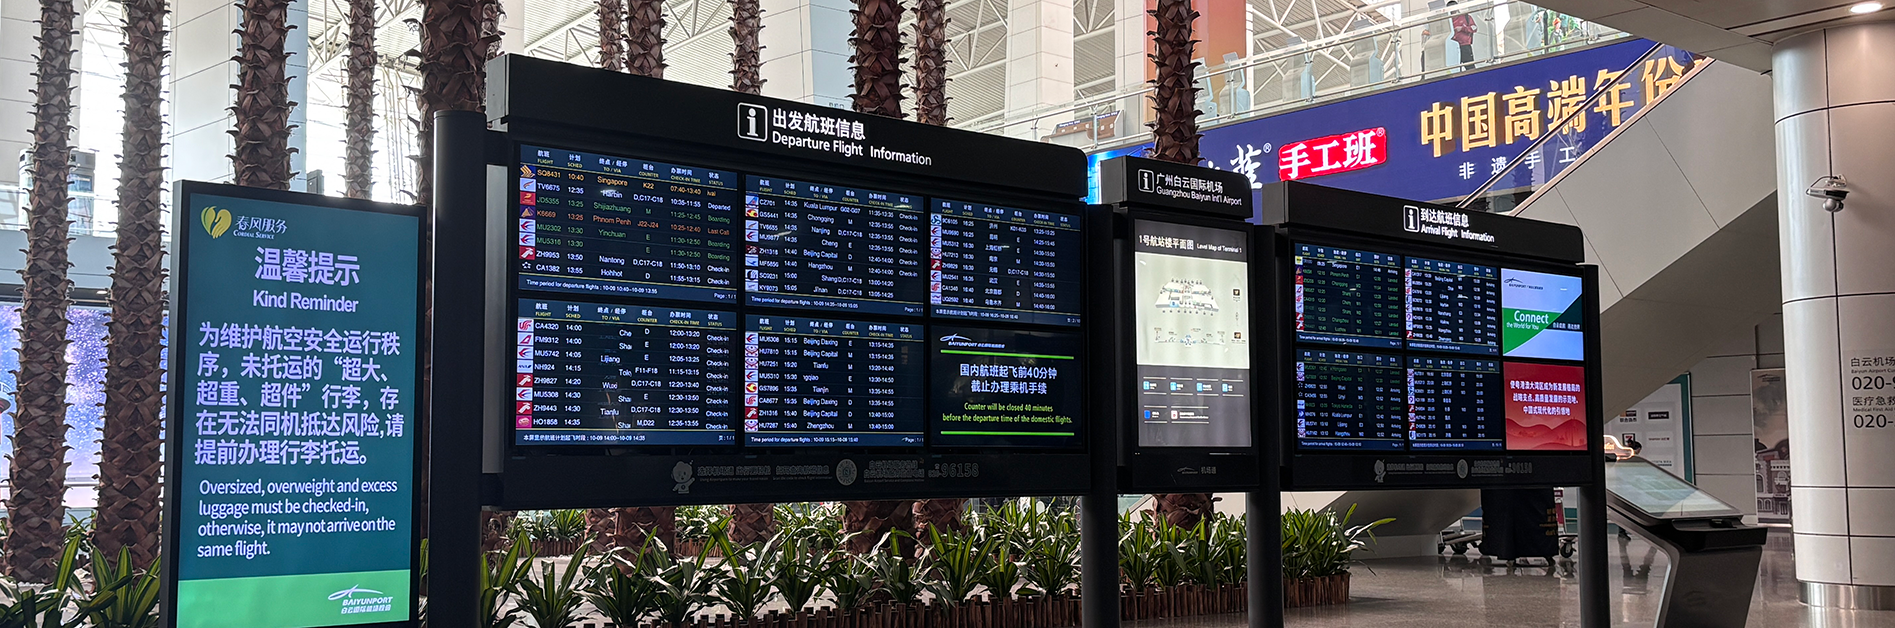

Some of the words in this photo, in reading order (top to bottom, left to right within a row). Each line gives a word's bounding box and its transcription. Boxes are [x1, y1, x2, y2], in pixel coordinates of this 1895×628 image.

[1420, 56, 1704, 158] 中国高端年份
[772, 108, 865, 140] 出发航班信息
[772, 131, 830, 151] Departure
[833, 140, 863, 157] Flight
[870, 146, 931, 165] Information
[1280, 131, 1377, 178] 手工班
[597, 176, 628, 186] Singapore
[1156, 173, 1223, 193] 广州白云国际机场
[1156, 186, 1190, 198] Guangzhou
[1191, 191, 1211, 202] Baiyun
[1223, 196, 1242, 205] Airport
[594, 202, 631, 213] Shijiazhuang
[708, 215, 730, 224] Boarding
[708, 203, 731, 211] Departed
[236, 215, 287, 234] 春风服务
[808, 214, 834, 223] Chongqing
[1420, 208, 1469, 227] 到达航班信息
[599, 229, 626, 238] Yinchuan
[708, 241, 730, 249] Boarding
[811, 227, 830, 235] Nanjing
[1421, 224, 1440, 235] Arrival
[1442, 226, 1458, 239] Flight
[1461, 230, 1494, 242] Information
[599, 256, 625, 265] Nantong
[804, 249, 820, 258] Beijing
[255, 247, 359, 286] 温馨提示
[253, 291, 286, 309] Kind
[291, 293, 358, 312] Reminder
[1514, 310, 1549, 324] Connect
[199, 322, 400, 355] 为维护航空安全运行秩
[601, 355, 620, 363] Lijiang
[960, 364, 1057, 379] 国内航班起飞前40分钟
[971, 380, 1047, 394] 截止办理乘机手续
[964, 402, 986, 411] Counter
[987, 403, 997, 411] will
[1007, 403, 1023, 411] closed
[943, 413, 961, 422] before
[962, 414, 971, 422] the
[973, 414, 999, 423] departure
[1001, 414, 1012, 422] time
[1014, 414, 1020, 422] of
[1021, 414, 1030, 423] the
[1031, 415, 1054, 423] domestic
[1055, 416, 1072, 425] flights.
[195, 439, 368, 466] 提前办理行李托运。
[199, 480, 264, 496] Oversized,
[267, 479, 335, 496] overweight
[338, 479, 359, 493] and
[362, 481, 397, 493] excess
[199, 501, 249, 518] luggage
[252, 501, 282, 514] must
[284, 499, 300, 513] be
[302, 499, 369, 514] checked-in,
[198, 520, 264, 537] otherwise,
[267, 520, 276, 533] it
[278, 521, 304, 537] may
[304, 519, 326, 532] not
[327, 517, 361, 531] arrive
[362, 519, 377, 531] on
[377, 517, 395, 530] the
[198, 544, 232, 556] same
[234, 540, 270, 560] flight.
[343, 597, 393, 606] BAIYUNPORT
